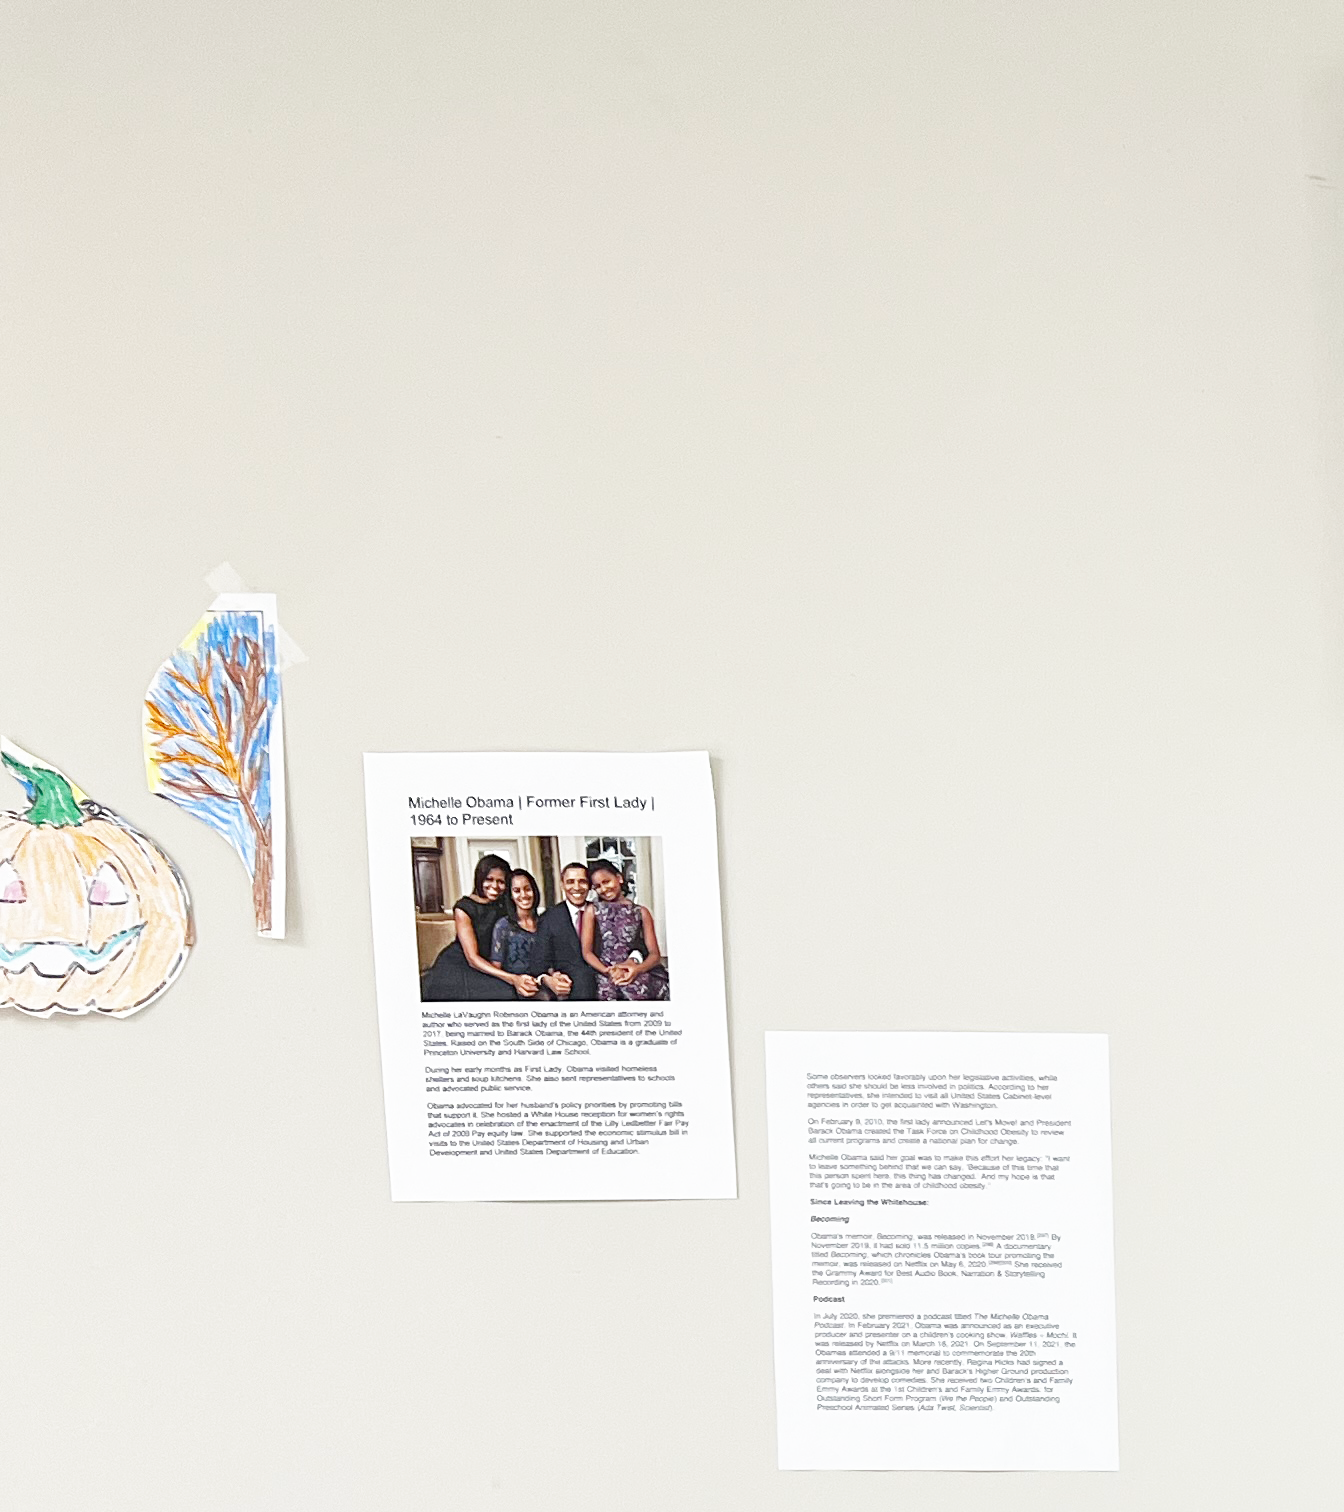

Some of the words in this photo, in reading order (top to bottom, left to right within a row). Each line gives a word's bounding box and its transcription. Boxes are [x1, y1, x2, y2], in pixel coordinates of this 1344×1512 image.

[408, 797, 462, 808] Michelle
[465, 796, 514, 808] Obama
[526, 796, 576, 808] Former
[579, 796, 610, 808] First
[614, 797, 647, 811] Lady
[411, 814, 442, 826] 1964
[446, 815, 458, 825] to
[462, 813, 514, 825] Present
